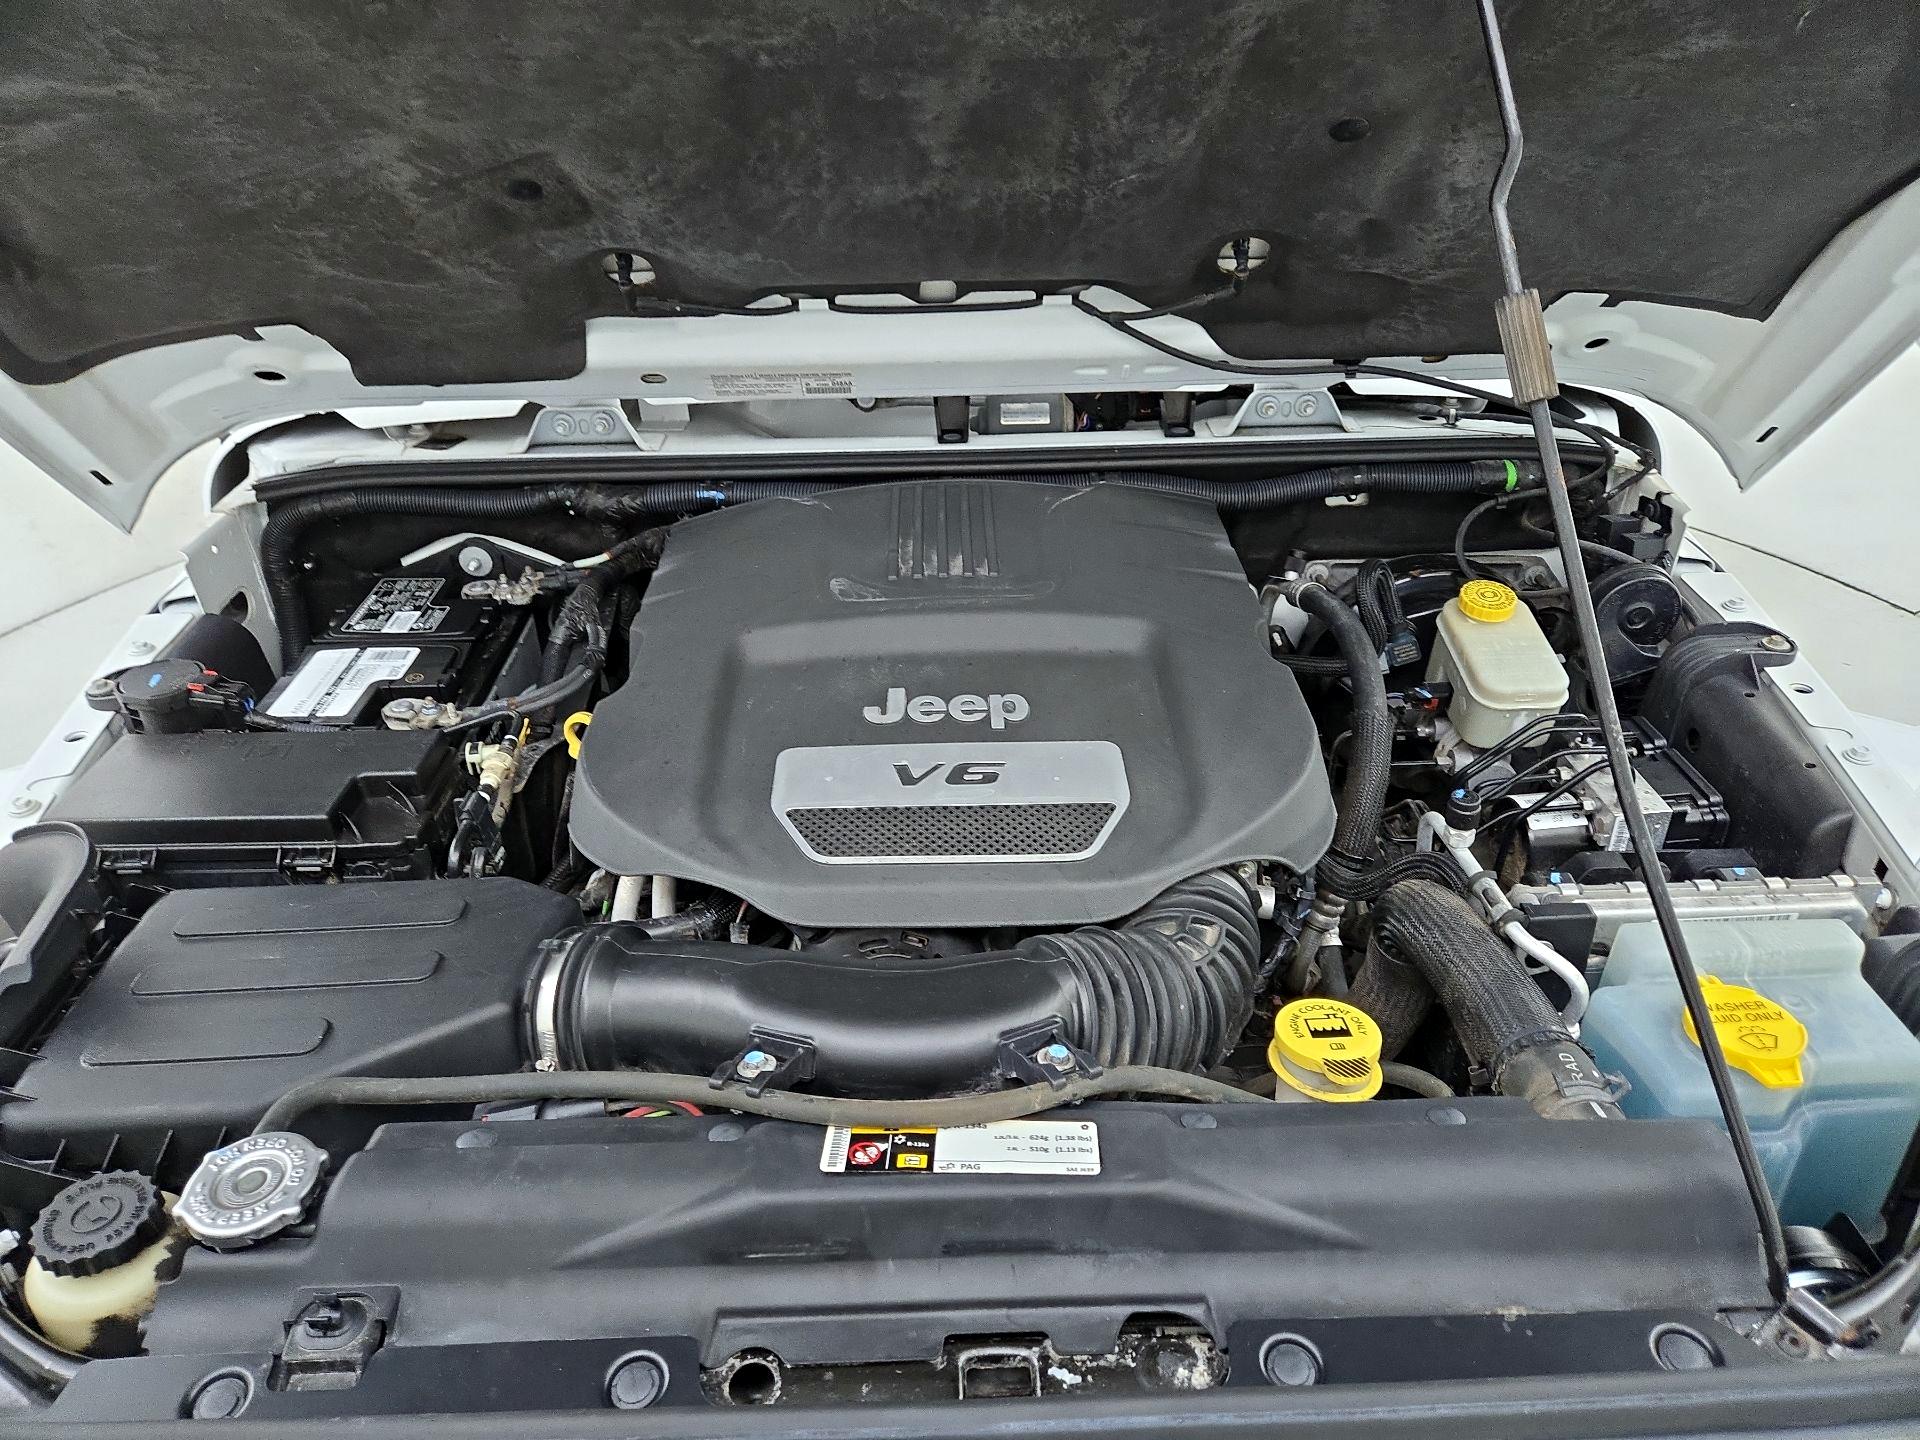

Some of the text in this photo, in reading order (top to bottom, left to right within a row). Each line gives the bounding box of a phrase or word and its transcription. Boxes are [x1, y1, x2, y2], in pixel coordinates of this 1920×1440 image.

[863, 687, 1030, 730] Jeep
[892, 762, 1007, 786] V6
[1299, 1004, 1351, 1015] COOLANT
[1351, 1016, 1368, 1036] ONLY
[1713, 1011, 1784, 1023] UID ONLY
[1559, 1053, 1584, 1081] RAD
[1029, 1134, 1049, 1142] 624g
[1029, 1146, 1049, 1154] 510g
[1055, 1146, 1076, 1154] (1.13
